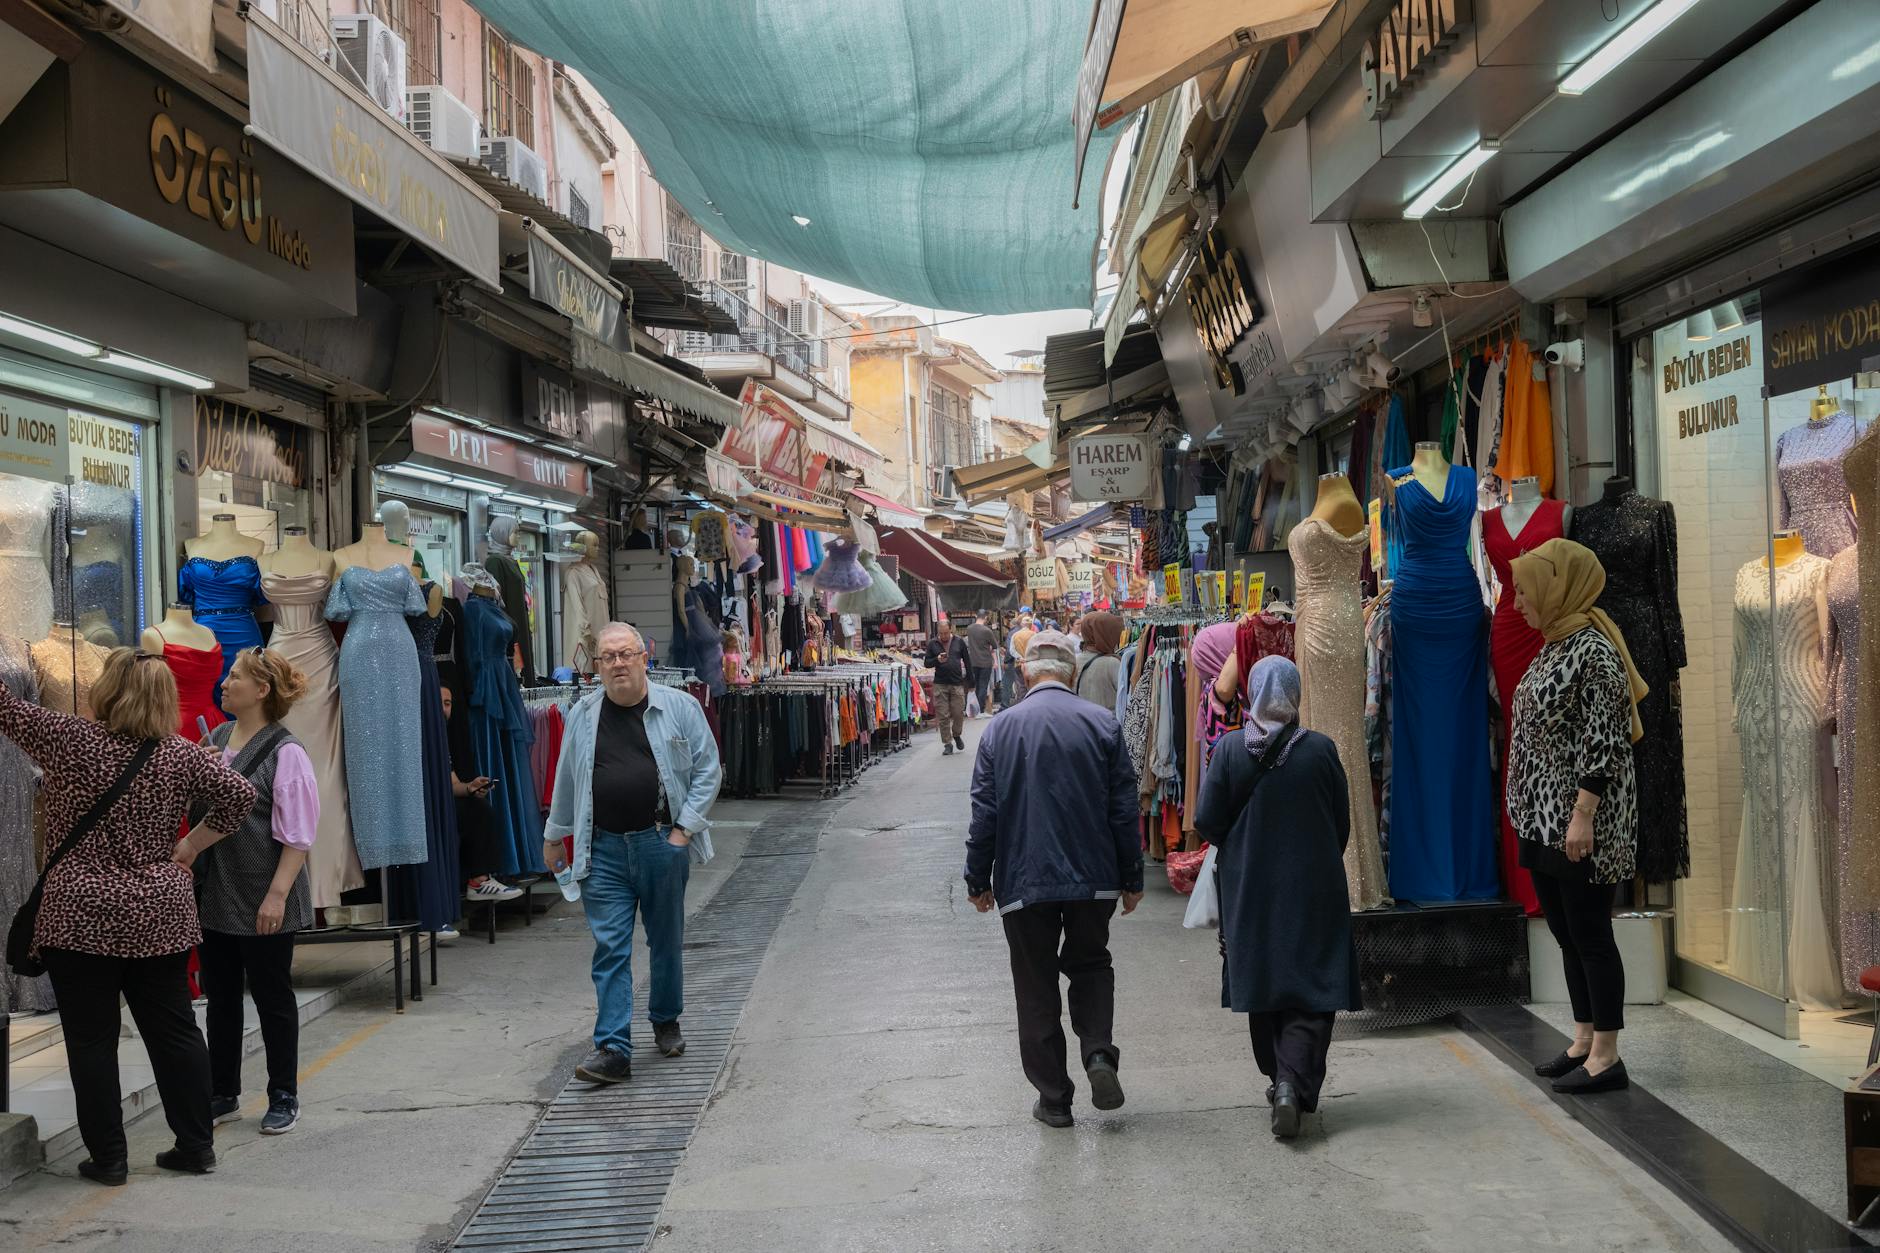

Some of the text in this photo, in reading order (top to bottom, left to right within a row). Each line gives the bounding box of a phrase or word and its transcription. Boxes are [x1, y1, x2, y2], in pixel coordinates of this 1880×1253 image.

[149, 84, 311, 270] ÖZGÜ Moda
[1771, 298, 1880, 369] SAYAN MODA
[1664, 335, 1752, 394] BÜYÜK BEDEN
[17, 416, 57, 447] MODA
[69, 413, 140, 457] BÜYÜK BEDEN
[193, 394, 243, 478] Dilek
[1679, 395, 1739, 439] BULUNUR
[82, 456, 131, 490] BULUNUR
[448, 428, 567, 487] PERİ GİYİM
[1077, 443, 1142, 465] HAREM
[1090, 466, 1130, 478] EŞARP
[1100, 486, 1123, 497] ŞAL
[1106, 478, 1116, 486] &
[1028, 564, 1054, 578] OĞUZ
